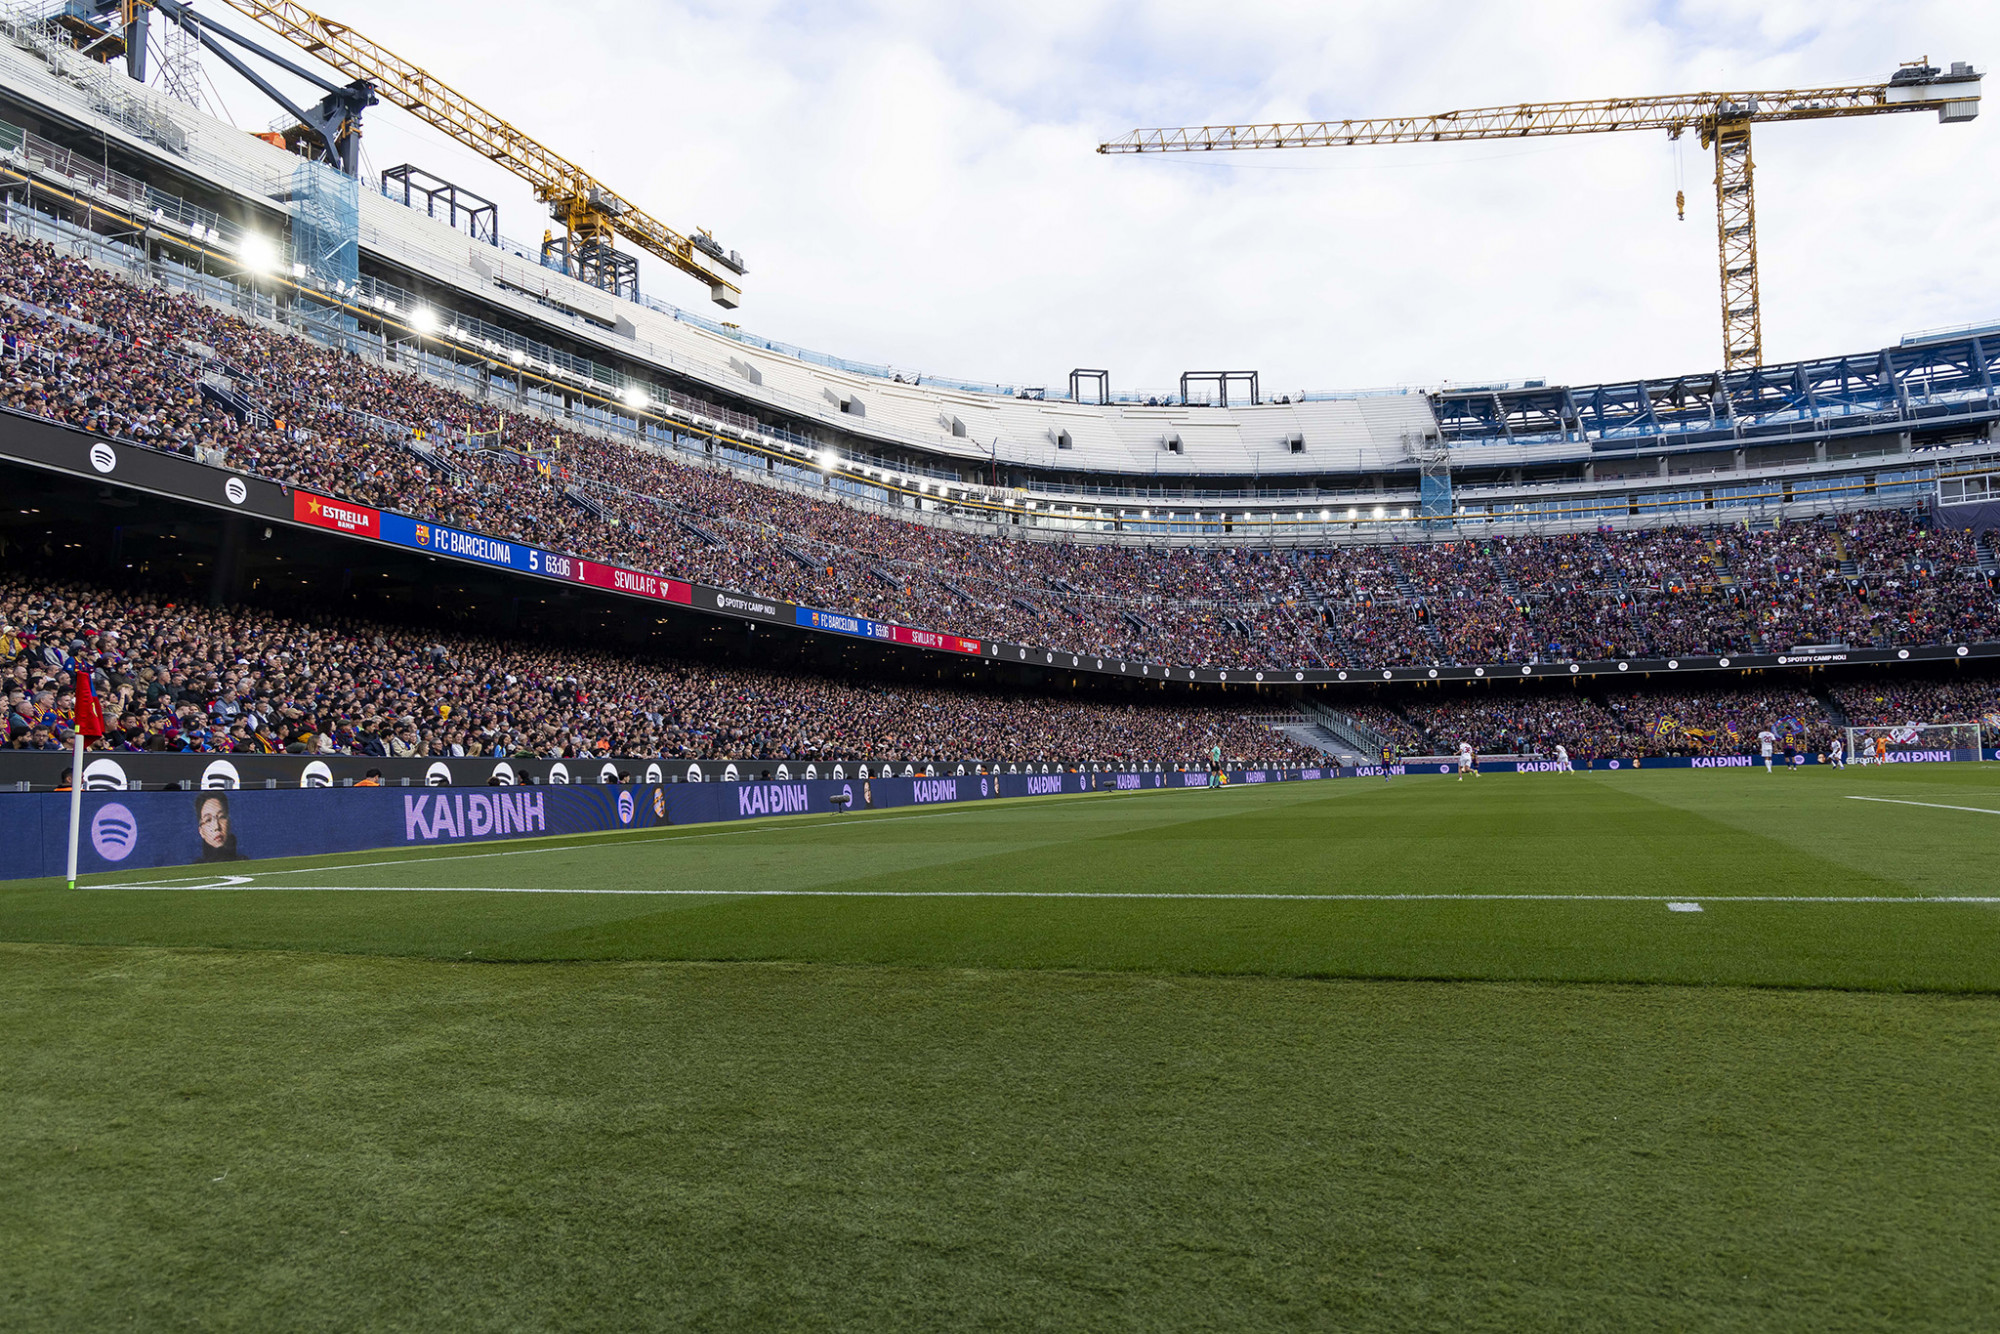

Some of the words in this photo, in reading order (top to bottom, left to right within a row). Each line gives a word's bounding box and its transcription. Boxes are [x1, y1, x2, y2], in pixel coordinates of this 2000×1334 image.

[322, 505, 369, 527] ESTRELLA
[434, 528, 449, 550] FC
[451, 532, 511, 564] BARCELONA
[529, 550, 538, 571] 5
[545, 555, 571, 577] 63:06
[578, 561, 585, 581] 1
[614, 570, 646, 593] SEVILLA
[646, 577, 656, 595] FC
[725, 597, 748, 611] SPOTIFY
[748, 602, 763, 613] CAMP
[764, 605, 776, 615] NOU
[821, 613, 828, 628] FC
[867, 622, 873, 636] 5
[892, 627, 897, 640] 1
[1691, 757, 1715, 768] KAI
[738, 785, 769, 815] KAI
[913, 780, 931, 803] KAI
[404, 794, 465, 840] KAI
